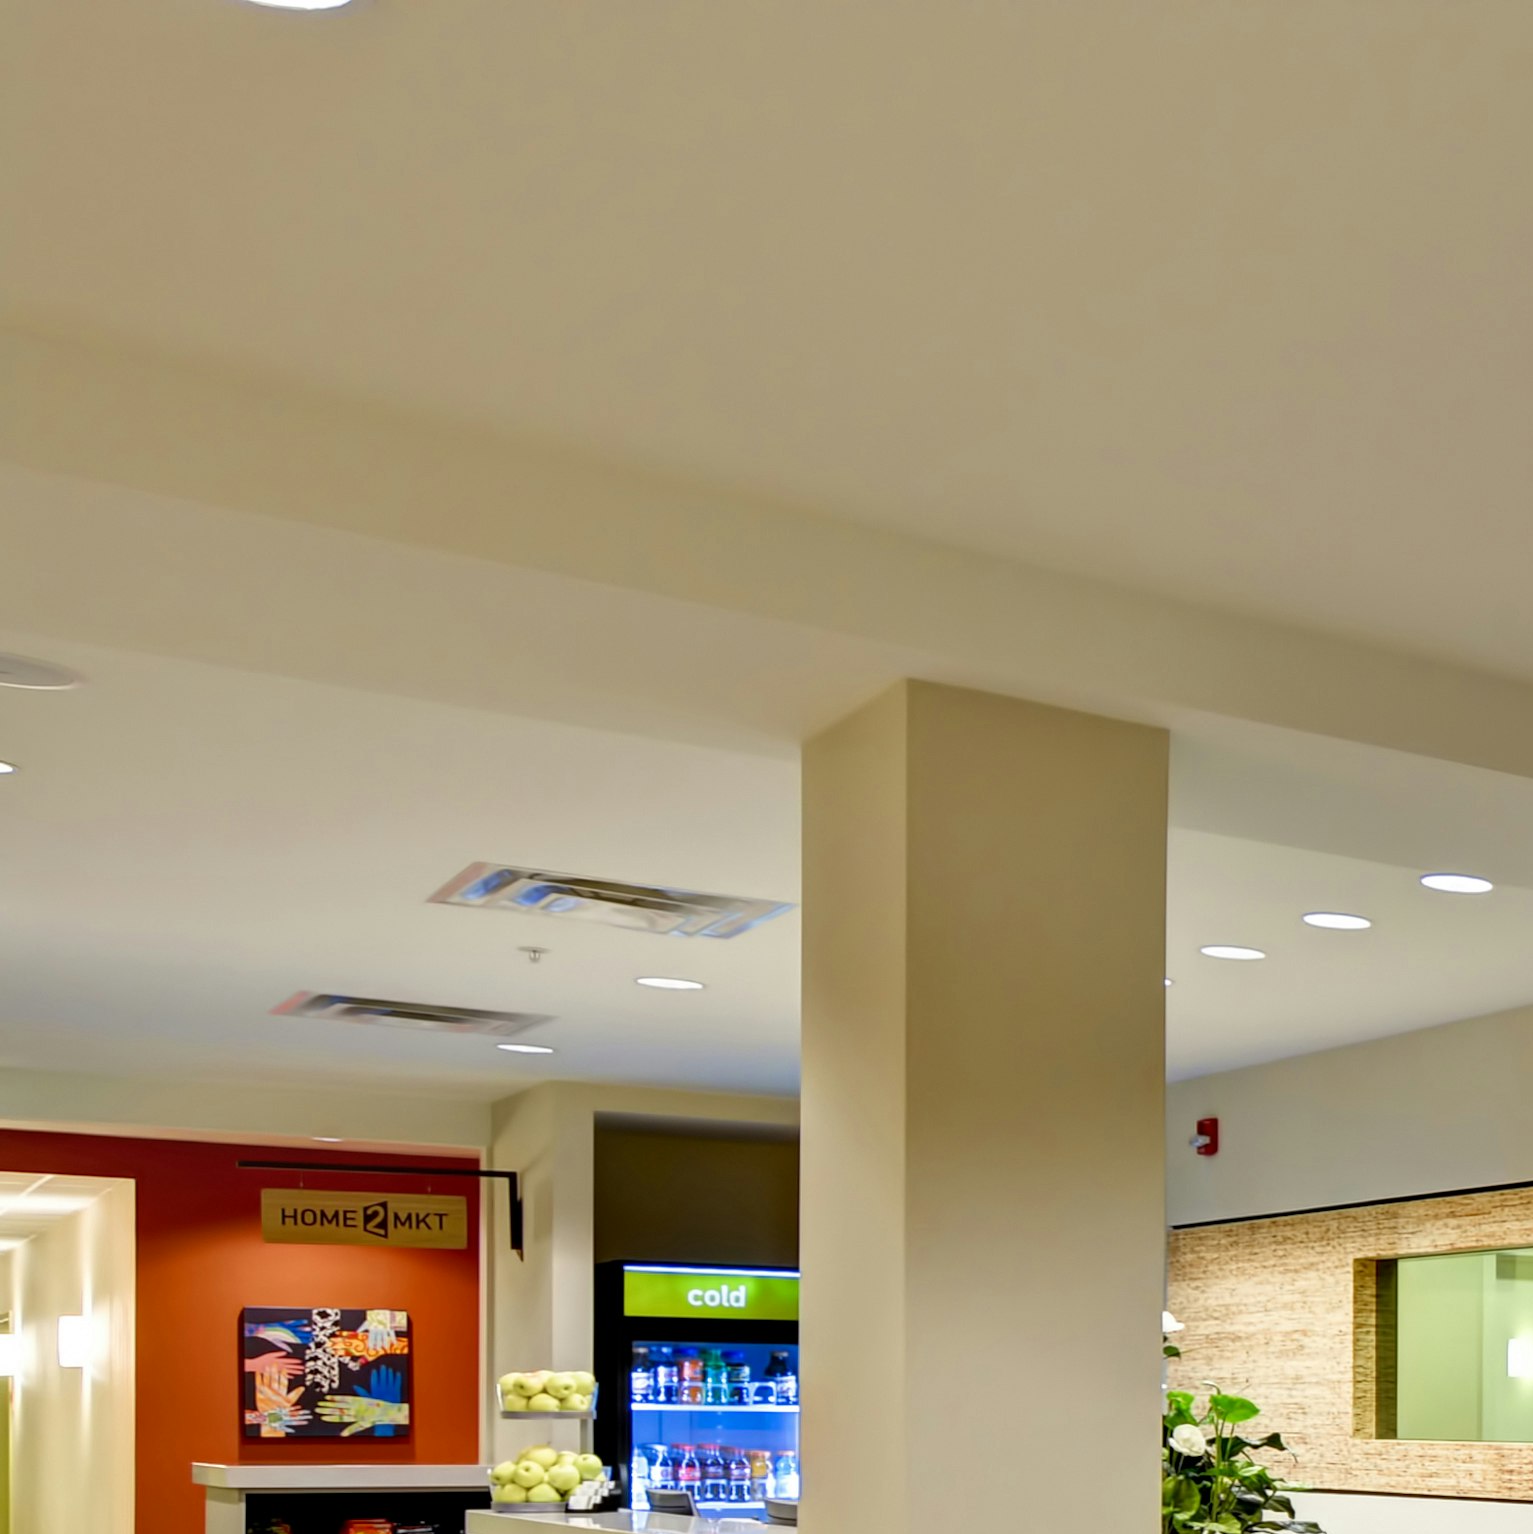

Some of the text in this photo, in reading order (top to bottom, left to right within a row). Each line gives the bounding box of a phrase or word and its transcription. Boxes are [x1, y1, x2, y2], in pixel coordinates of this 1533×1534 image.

[280, 1202, 449, 1238] HOME 2 MKT
[687, 1285, 747, 1309] cold
